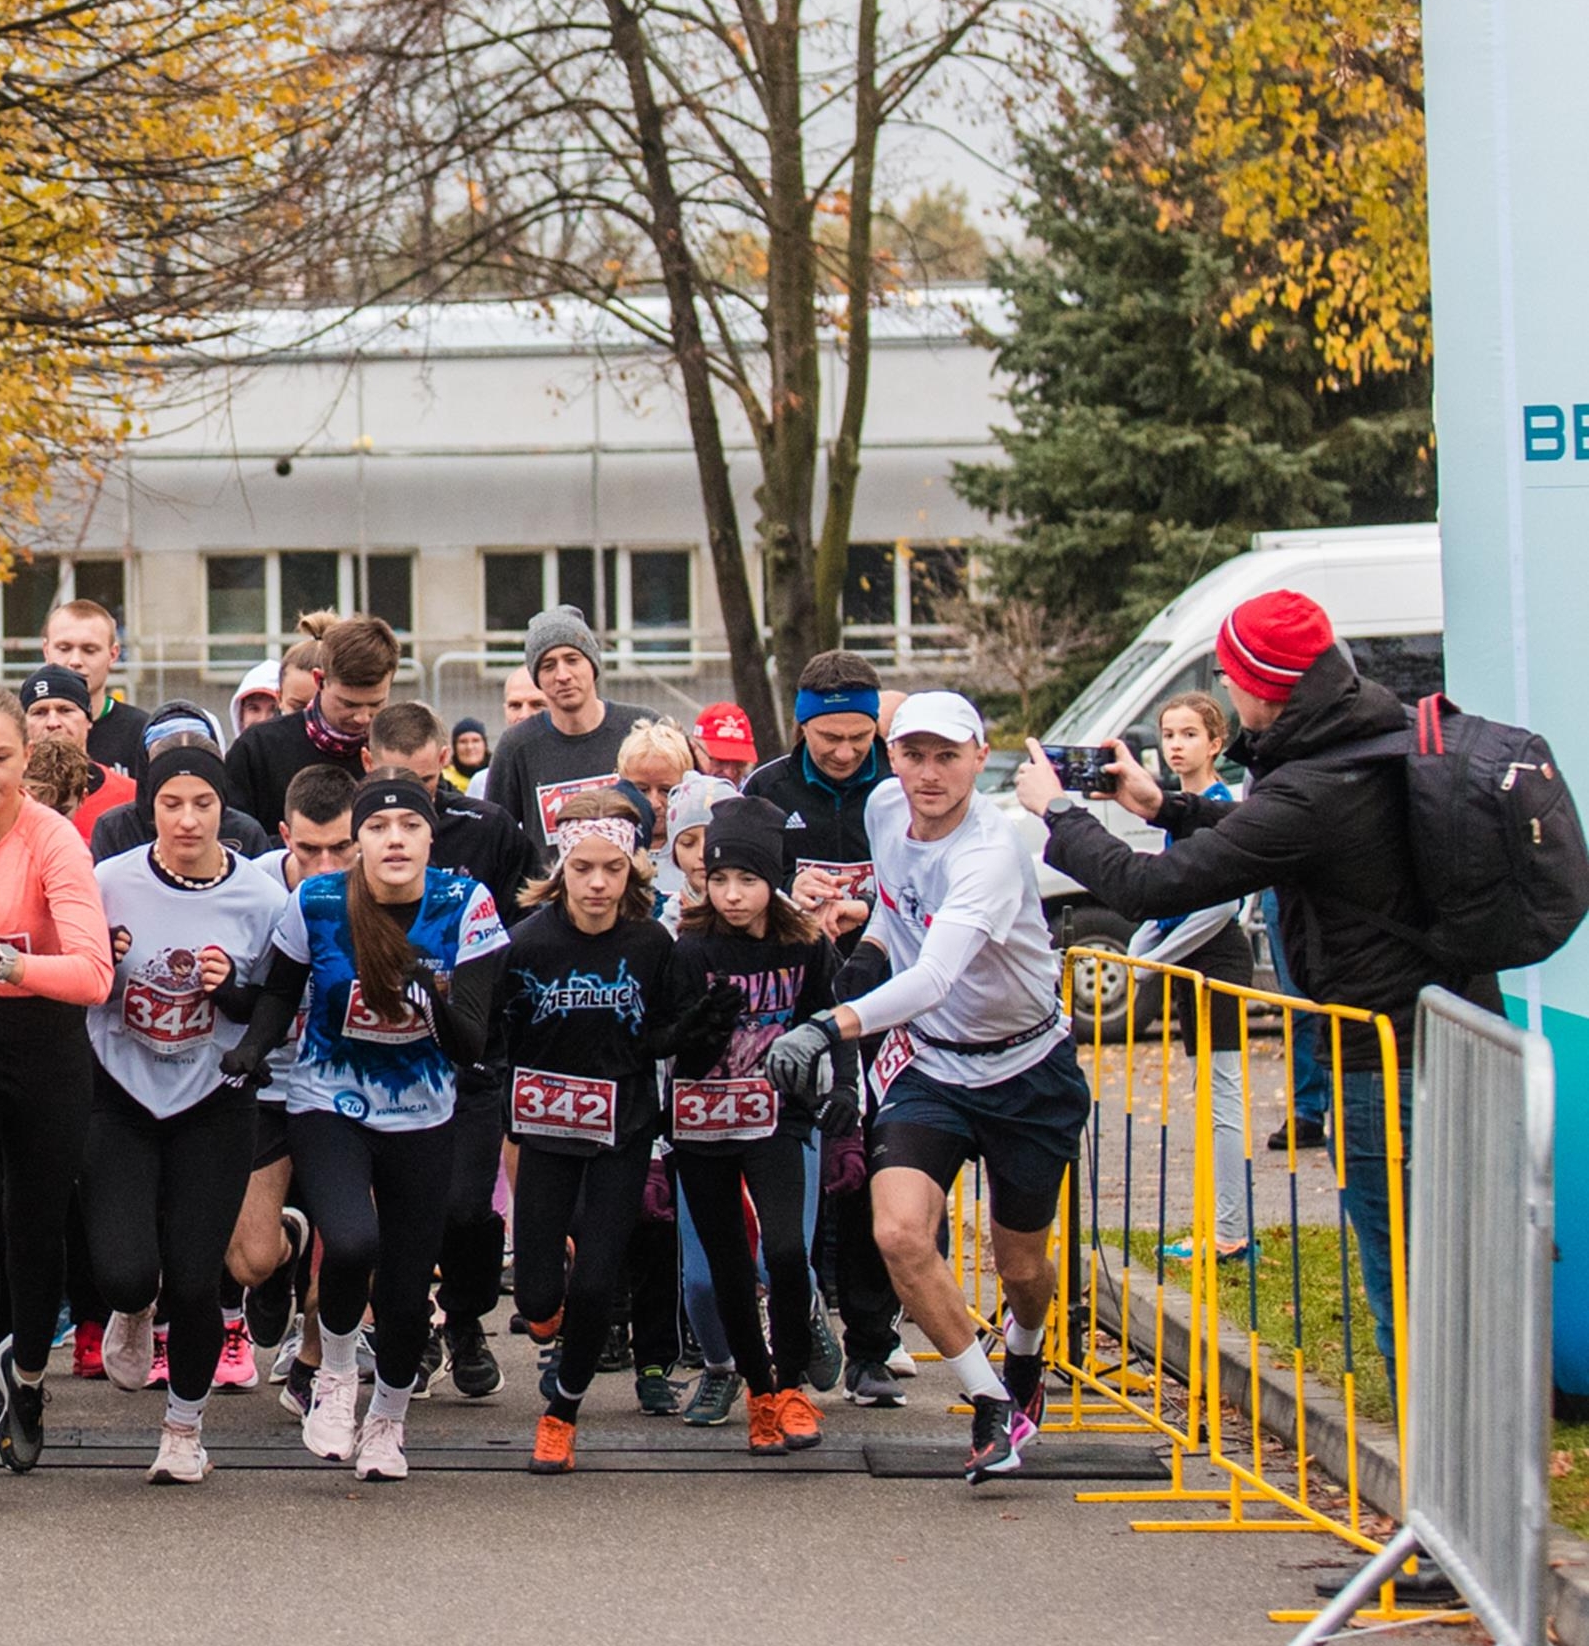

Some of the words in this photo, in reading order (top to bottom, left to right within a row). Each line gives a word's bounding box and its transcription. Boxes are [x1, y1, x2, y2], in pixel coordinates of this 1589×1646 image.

[128, 994, 212, 1037] 344
[517, 1085, 608, 1127] 342
[679, 1092, 771, 1126] 343
